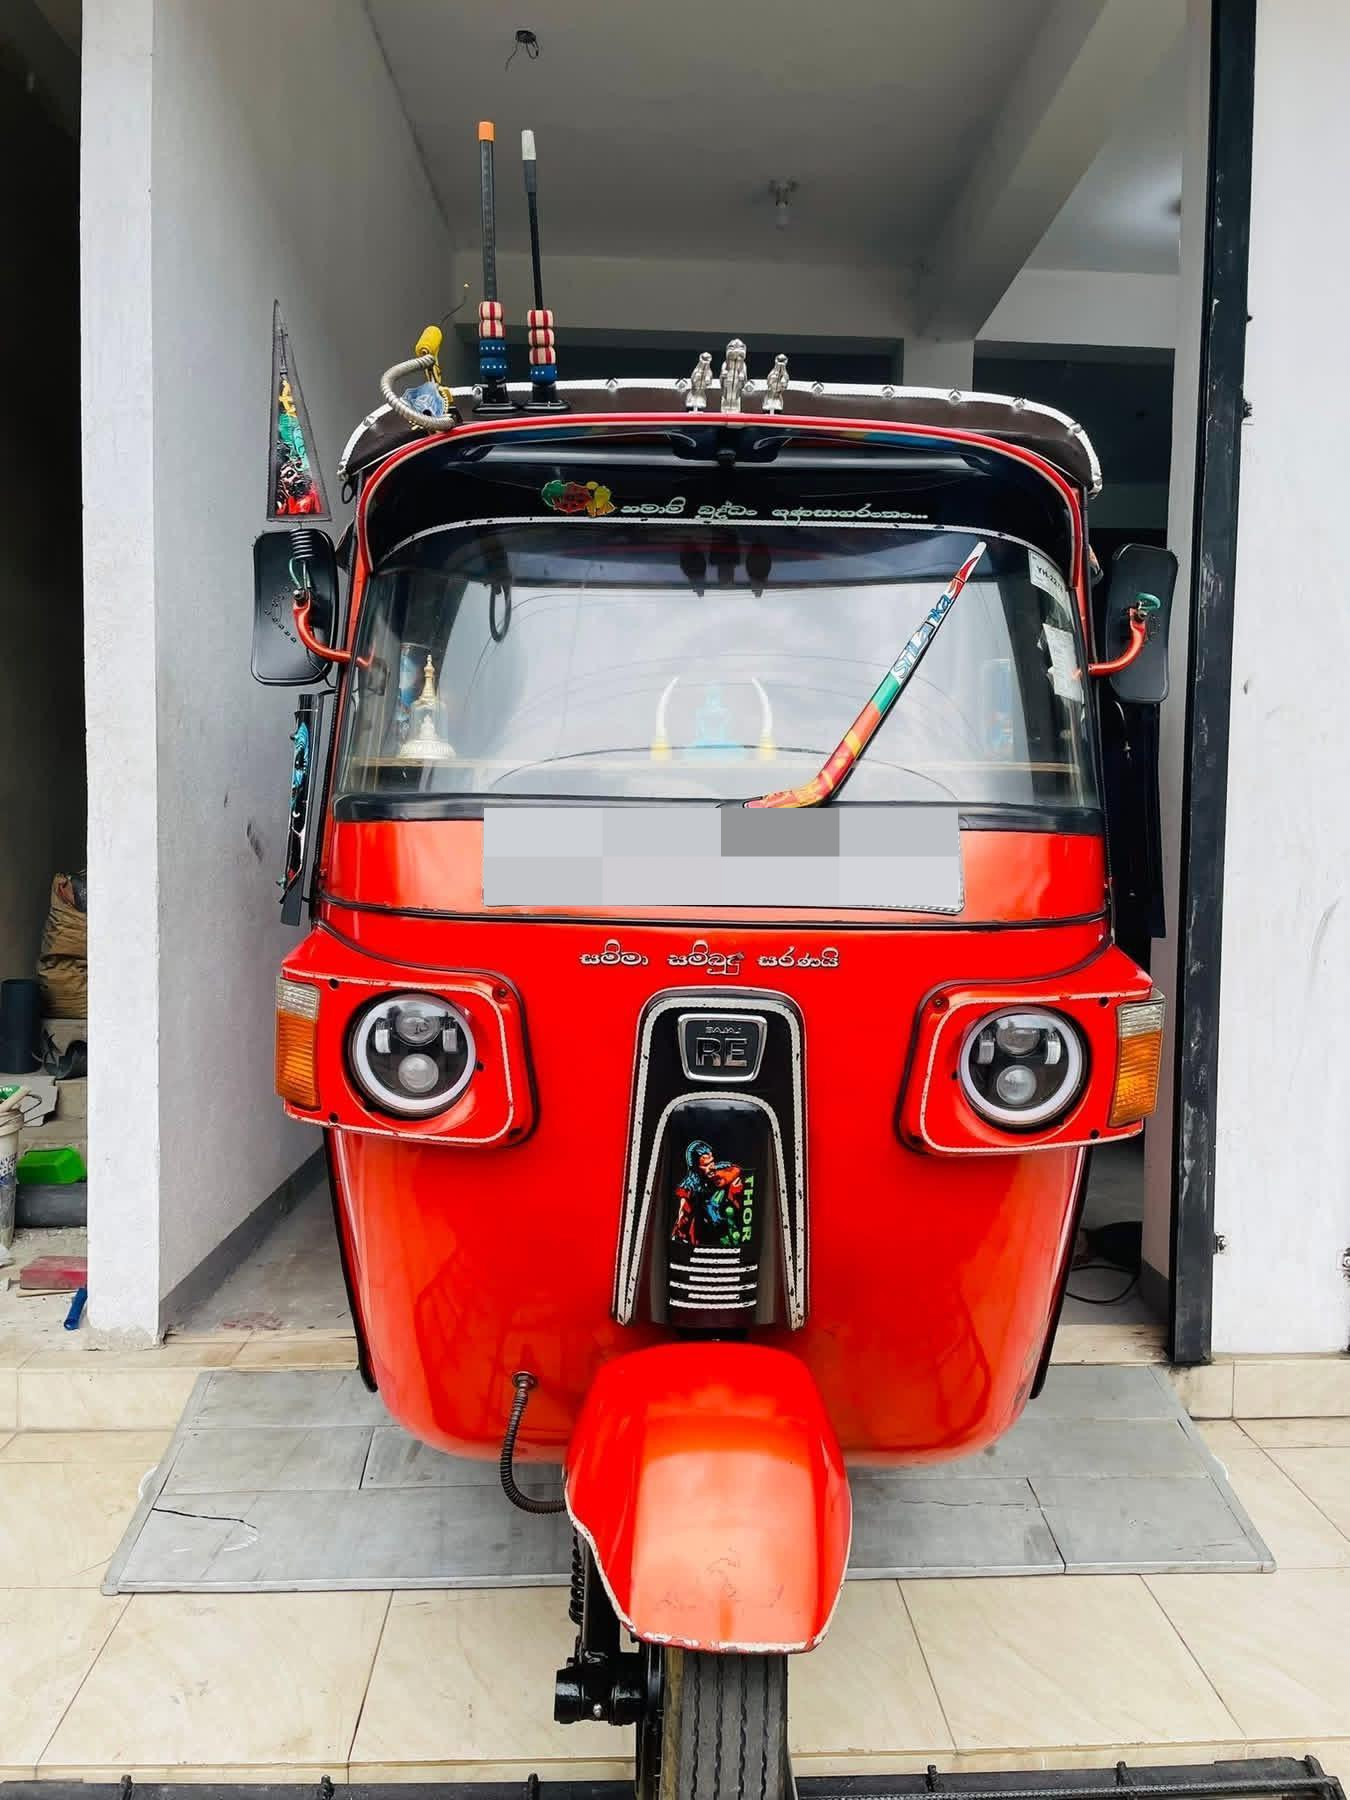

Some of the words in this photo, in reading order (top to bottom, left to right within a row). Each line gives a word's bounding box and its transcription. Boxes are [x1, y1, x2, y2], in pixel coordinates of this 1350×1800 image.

[579, 938, 649, 966] සම්මා
[695, 1037, 748, 1067] RE
[741, 1175, 755, 1243] THOR
